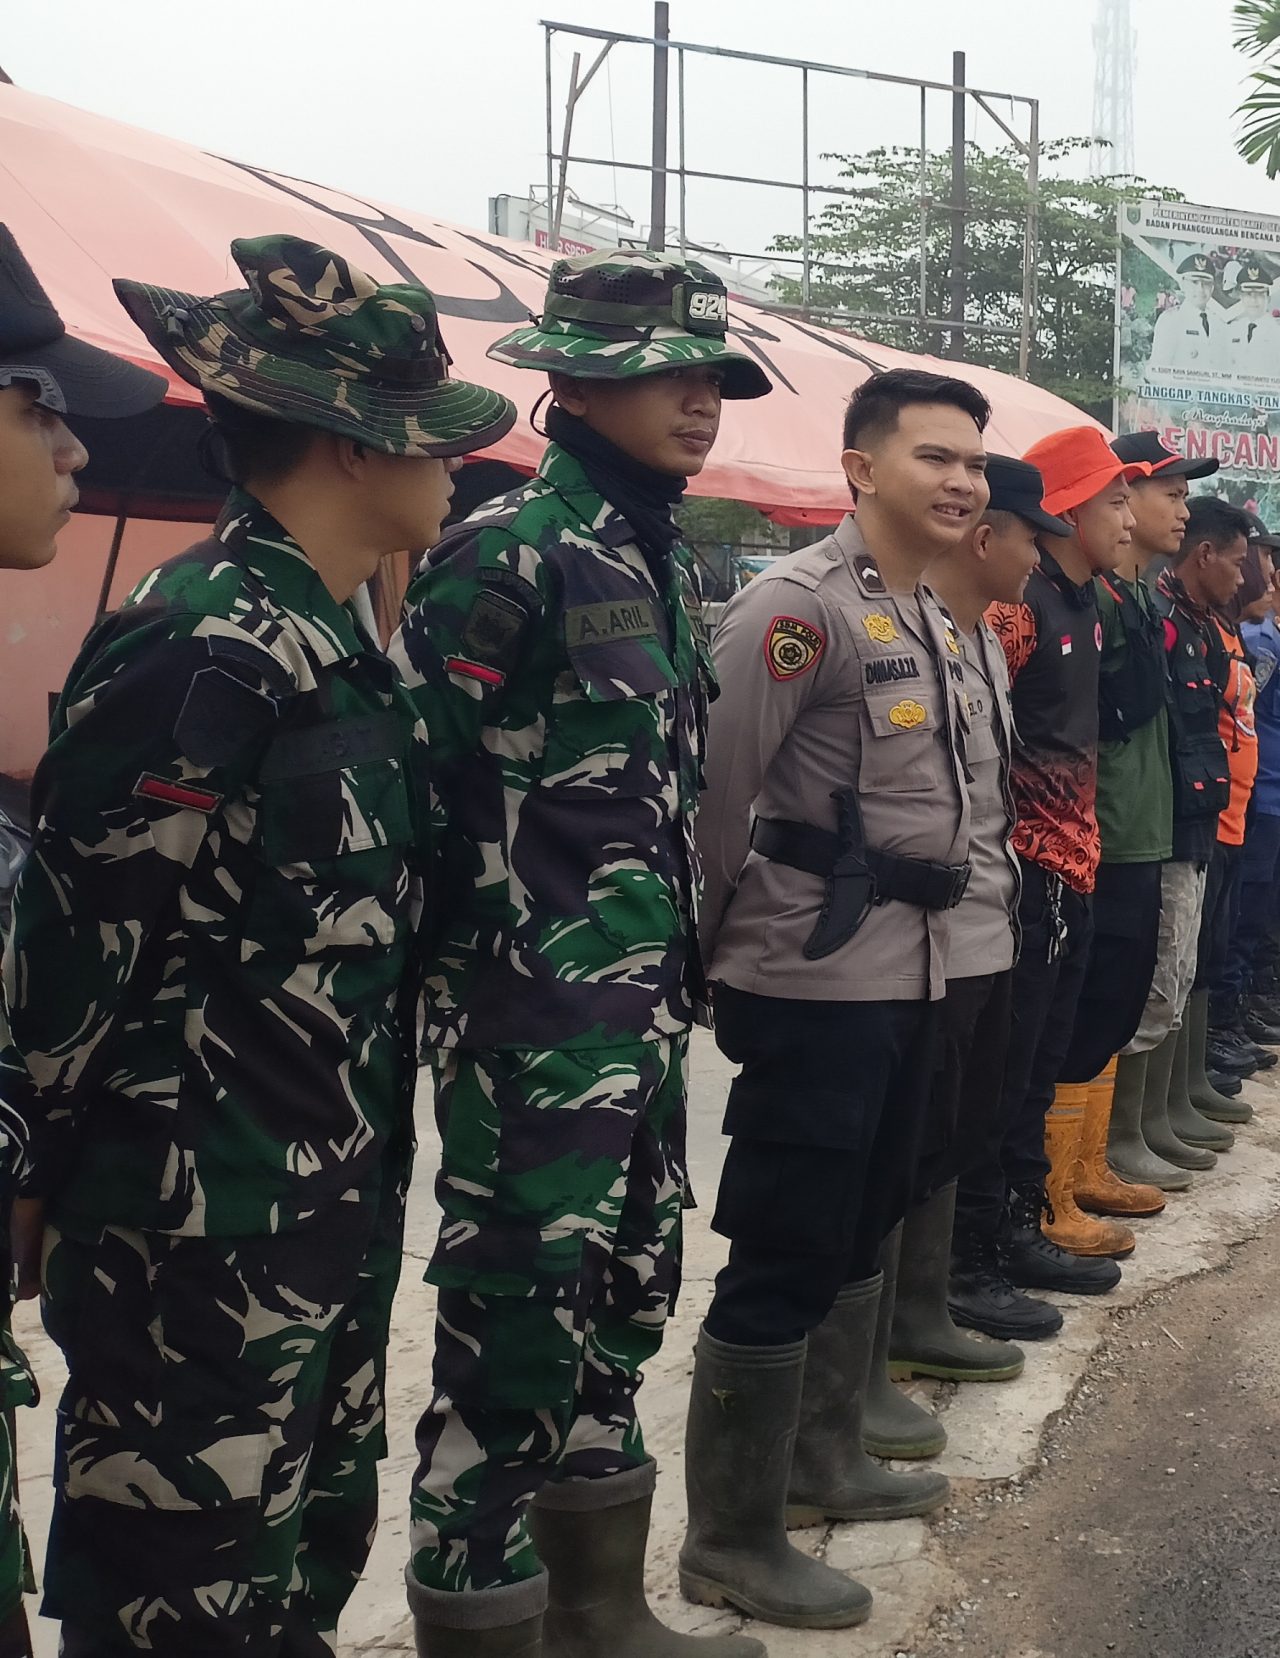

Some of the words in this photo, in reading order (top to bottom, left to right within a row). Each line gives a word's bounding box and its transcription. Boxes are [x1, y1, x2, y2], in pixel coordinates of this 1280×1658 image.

[1146, 219, 1170, 229] BADAN
[1172, 222, 1239, 237] PENANGGULANGAN
[1241, 230, 1274, 242] BENCANA
[688, 292, 727, 321] 924
[1182, 408, 1268, 430] Menghadapi
